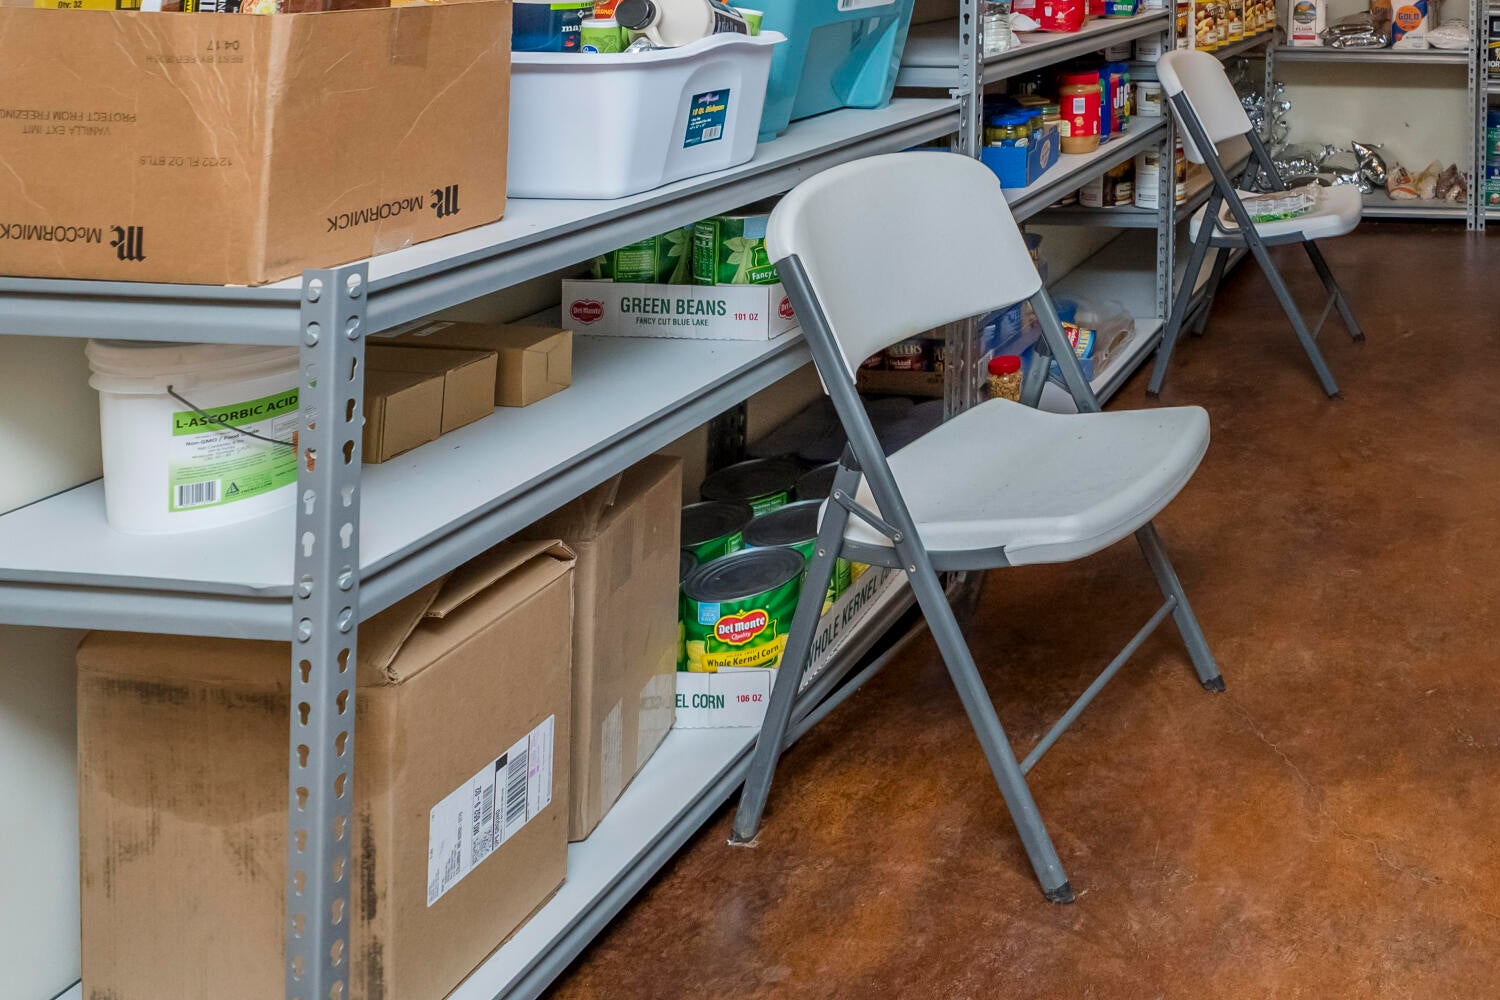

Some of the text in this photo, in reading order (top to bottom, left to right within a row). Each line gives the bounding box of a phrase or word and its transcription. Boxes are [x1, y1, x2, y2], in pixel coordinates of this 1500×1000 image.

[1398, 12, 1419, 20] GOLD
[53, 111, 84, 121] FROM
[90, 112, 136, 122] PROTECT
[45, 126, 65, 136] EXT
[69, 126, 111, 136] VANILLA
[327, 195, 424, 232] McCORMICK
[0, 223, 102, 244] McCORMICK
[751, 271, 772, 281] Fancy
[620, 297, 727, 317] GREEN BEANS
[636, 316, 709, 327] FANCY CUT BLUE LAKE
[734, 313, 759, 321] 101 OZ
[176, 395, 298, 429] L-ASCORBIC ACID
[841, 576, 878, 627] KERNEL
[718, 616, 765, 635] Del Monte
[731, 630, 752, 641] Quality
[706, 655, 732, 667] Whole
[732, 652, 760, 666] Kernel
[761, 644, 779, 657] Corn
[692, 694, 725, 709] CORN
[752, 694, 762, 702] OZ
